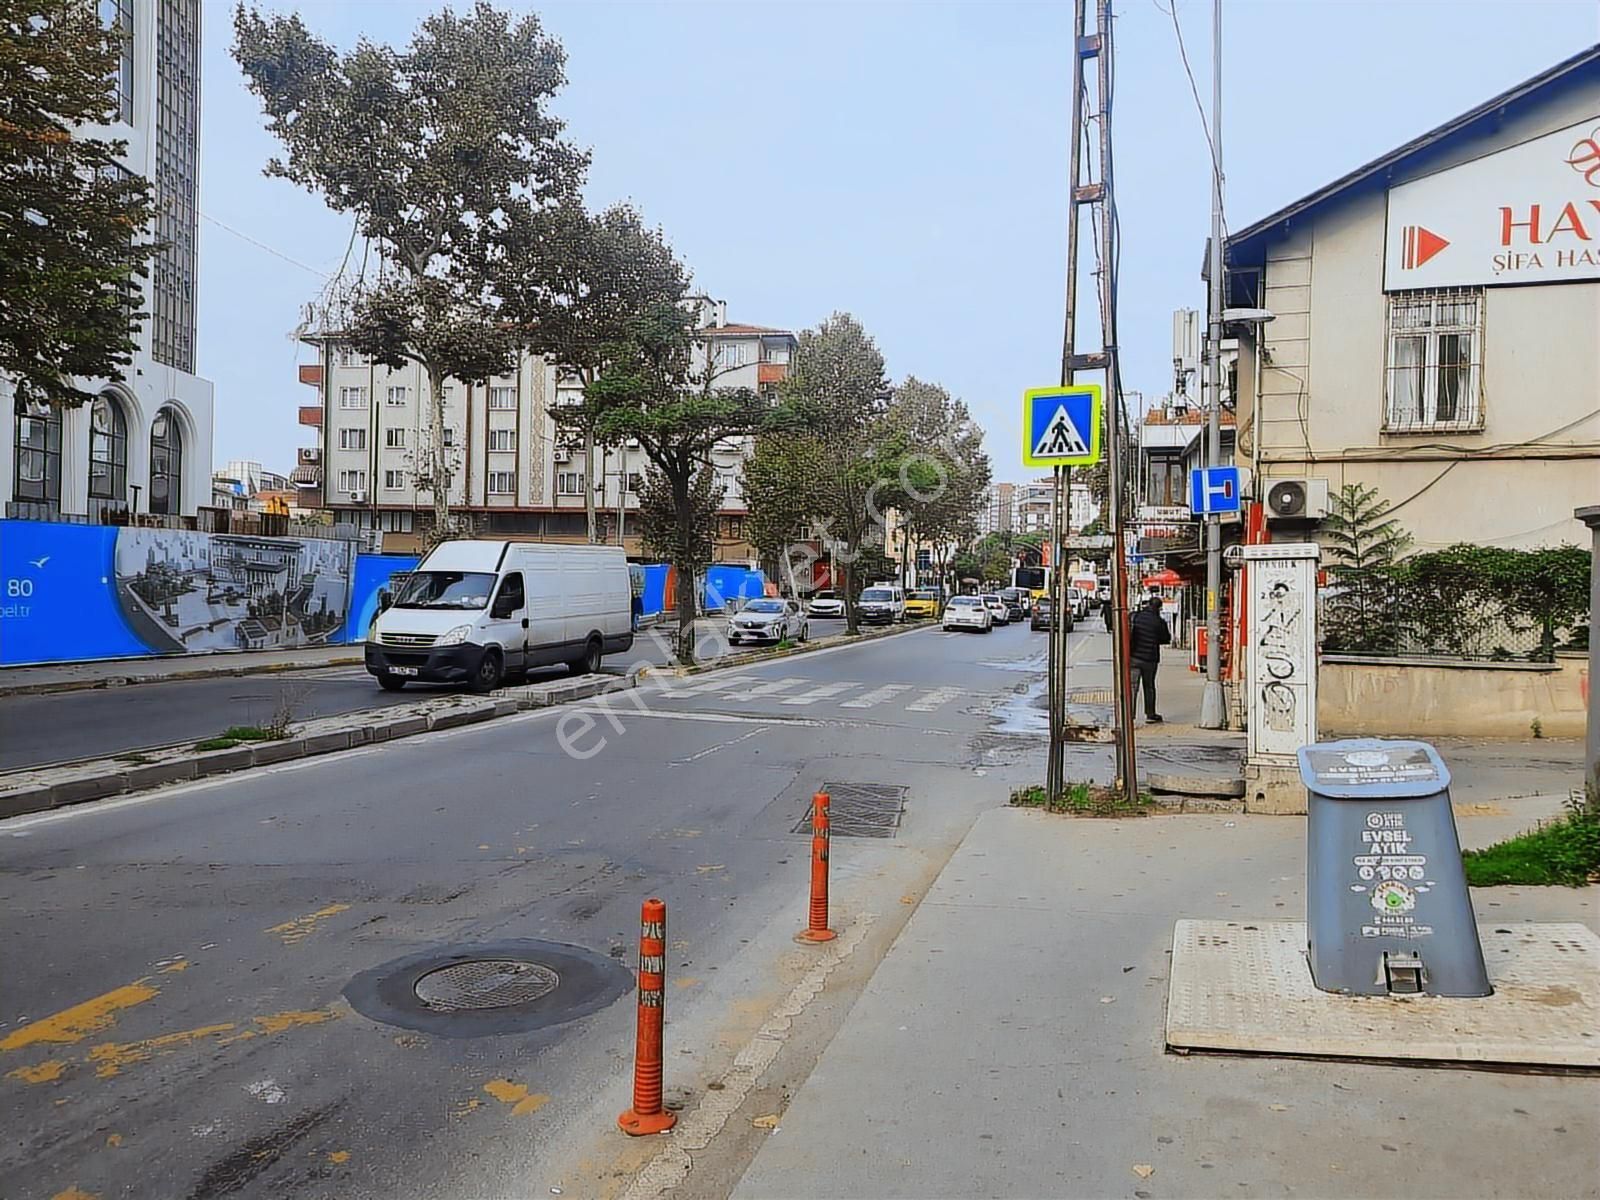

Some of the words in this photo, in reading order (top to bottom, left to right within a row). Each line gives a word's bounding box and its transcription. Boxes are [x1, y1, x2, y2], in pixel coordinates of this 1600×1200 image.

[1492, 250, 1543, 276] ŞİFA
[1557, 249, 1600, 268] HA
[7, 579, 33, 597] 80
[1361, 830, 1412, 842] EVSEL
[1370, 842, 1407, 854] ATIK
